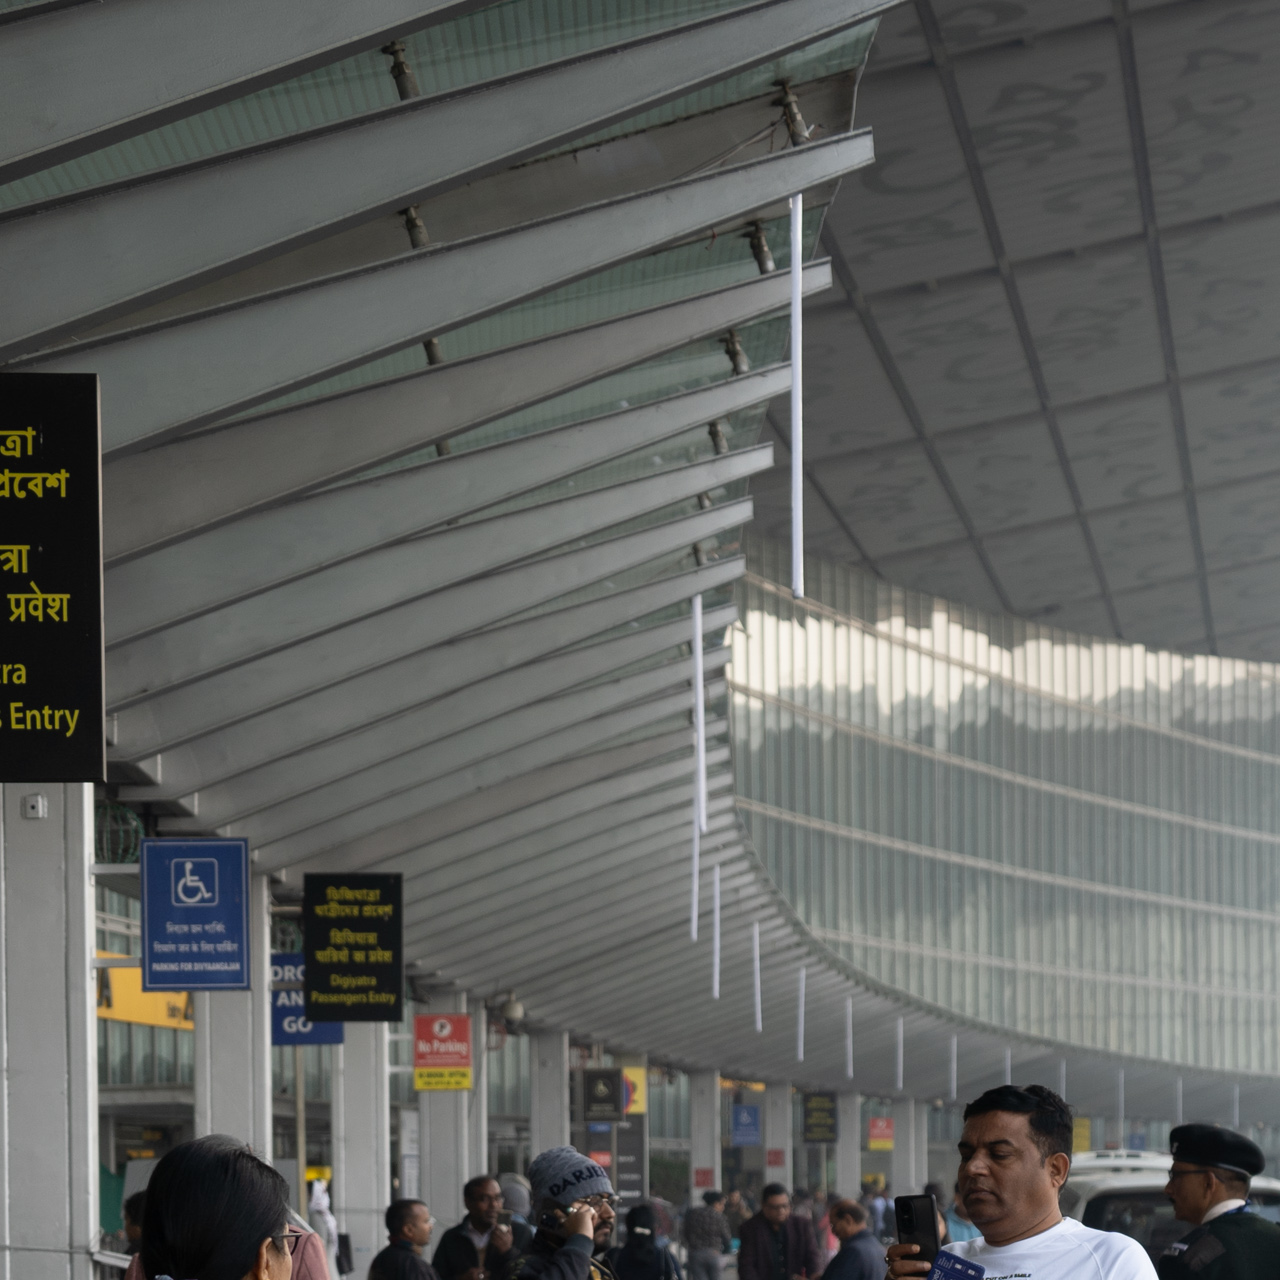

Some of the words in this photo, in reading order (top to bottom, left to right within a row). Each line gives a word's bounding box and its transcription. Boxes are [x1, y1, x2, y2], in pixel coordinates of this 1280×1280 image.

[7, 581, 70, 622] प्रवेश
[10, 702, 80, 738] Entry
[271, 965, 306, 982] DRO
[330, 973, 377, 988] Digiyatra
[276, 990, 305, 1007] AN
[311, 991, 367, 1006] Passengers
[368, 991, 396, 1006] Entry
[283, 1016, 313, 1033] GO
[418, 1040, 431, 1053] No
[433, 1040, 468, 1057] Parking
